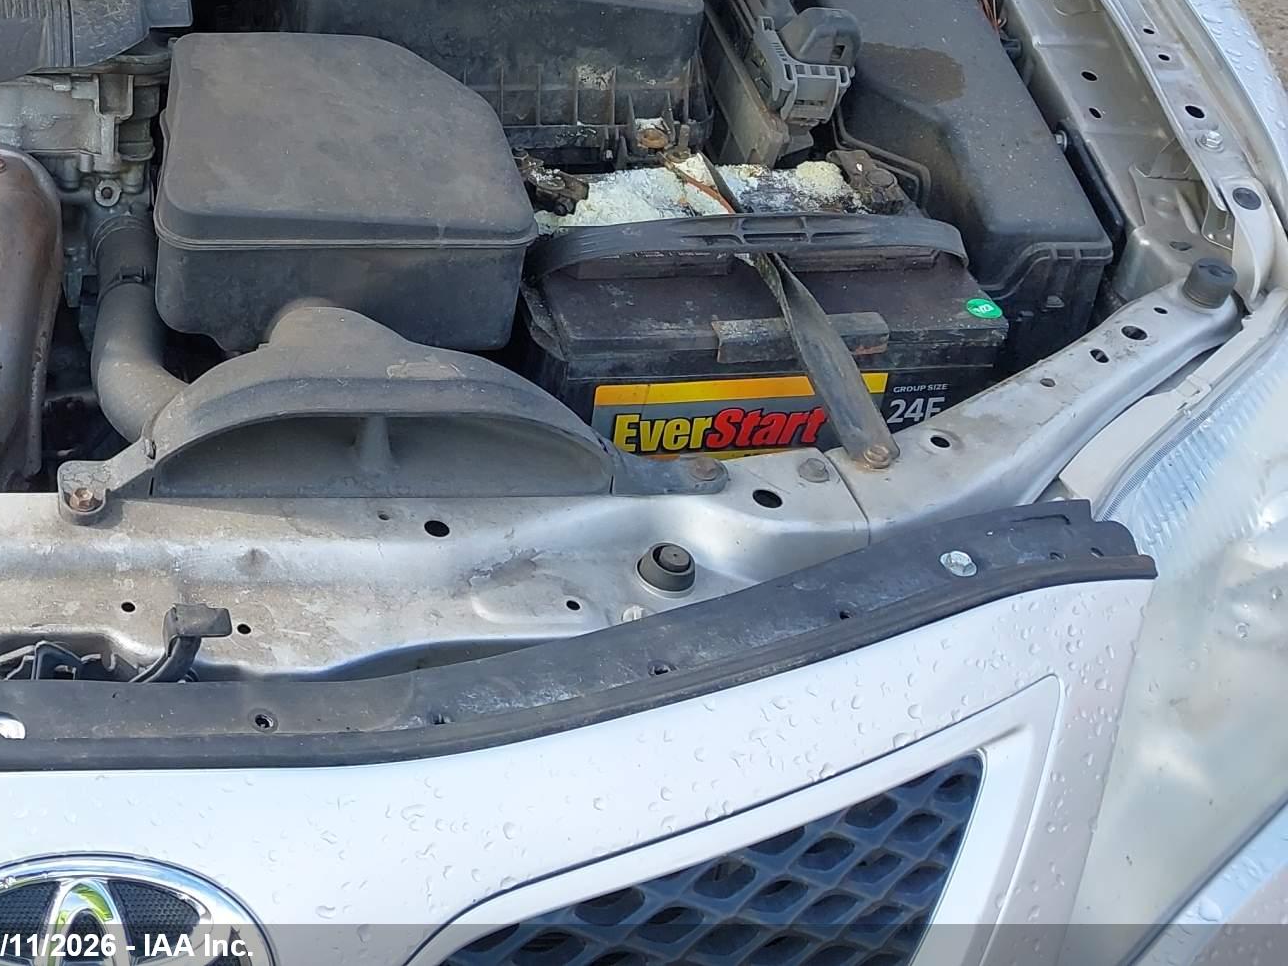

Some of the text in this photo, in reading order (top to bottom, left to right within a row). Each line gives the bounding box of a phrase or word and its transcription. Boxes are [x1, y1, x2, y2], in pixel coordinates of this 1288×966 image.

[892, 383, 949, 394] GROUP SIZE
[613, 406, 827, 453] EverStart
